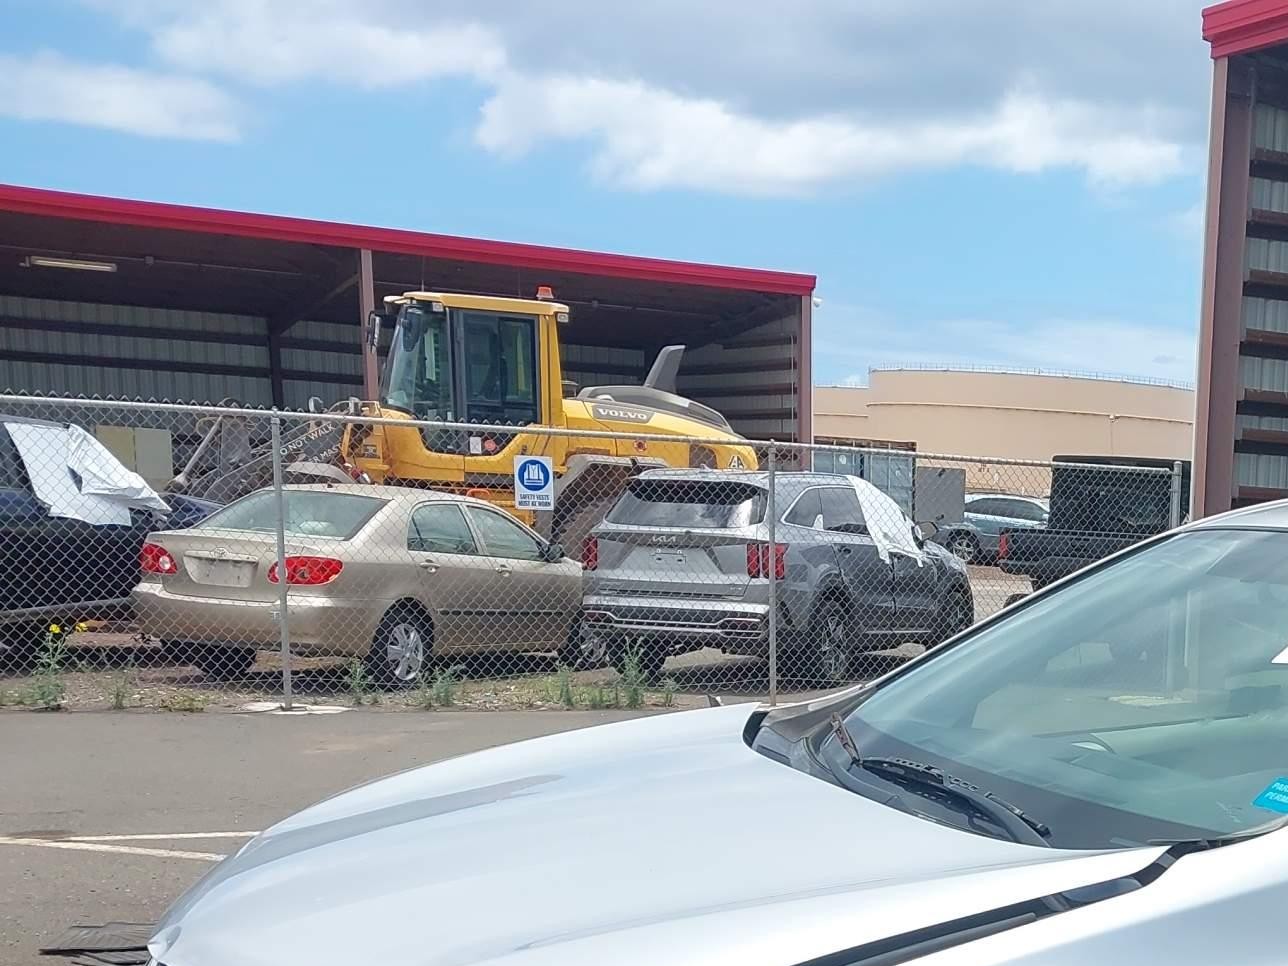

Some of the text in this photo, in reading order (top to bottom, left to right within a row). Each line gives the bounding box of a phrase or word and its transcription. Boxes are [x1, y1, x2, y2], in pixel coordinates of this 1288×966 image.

[597, 407, 648, 420] VOLVO
[288, 436, 308, 451] NOT
[307, 423, 337, 441] WALK
